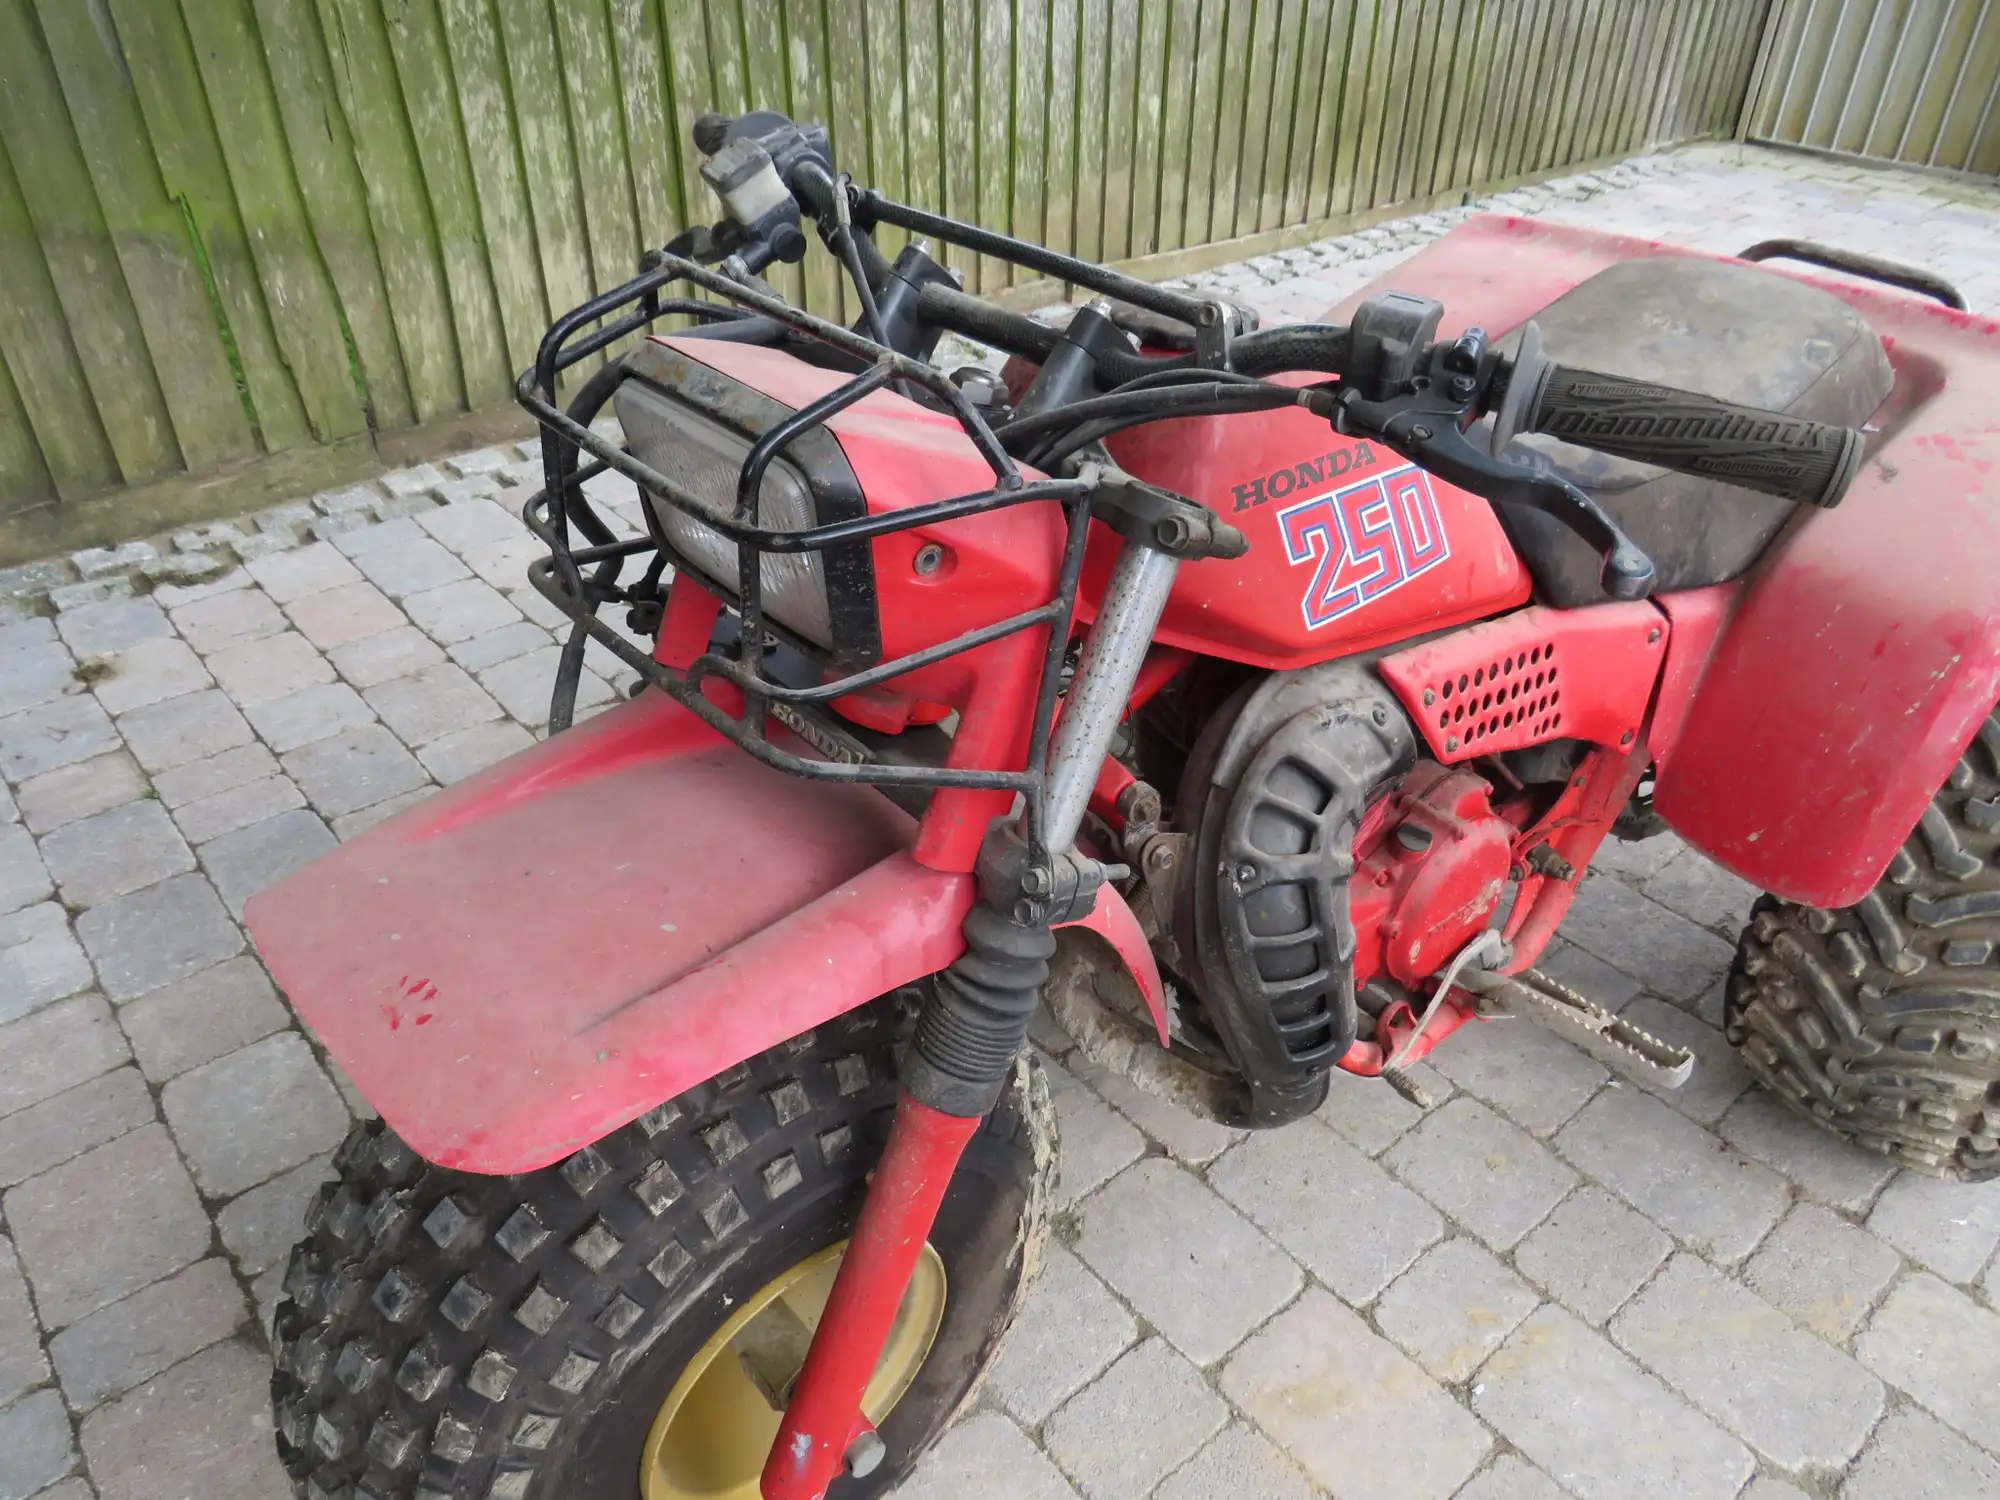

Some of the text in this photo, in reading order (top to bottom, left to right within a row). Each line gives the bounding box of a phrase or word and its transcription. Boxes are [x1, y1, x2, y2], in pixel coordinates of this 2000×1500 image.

[1231, 442, 1376, 512] HONDA
[1276, 462, 1450, 631] 250
[771, 701, 864, 765] HONDA
